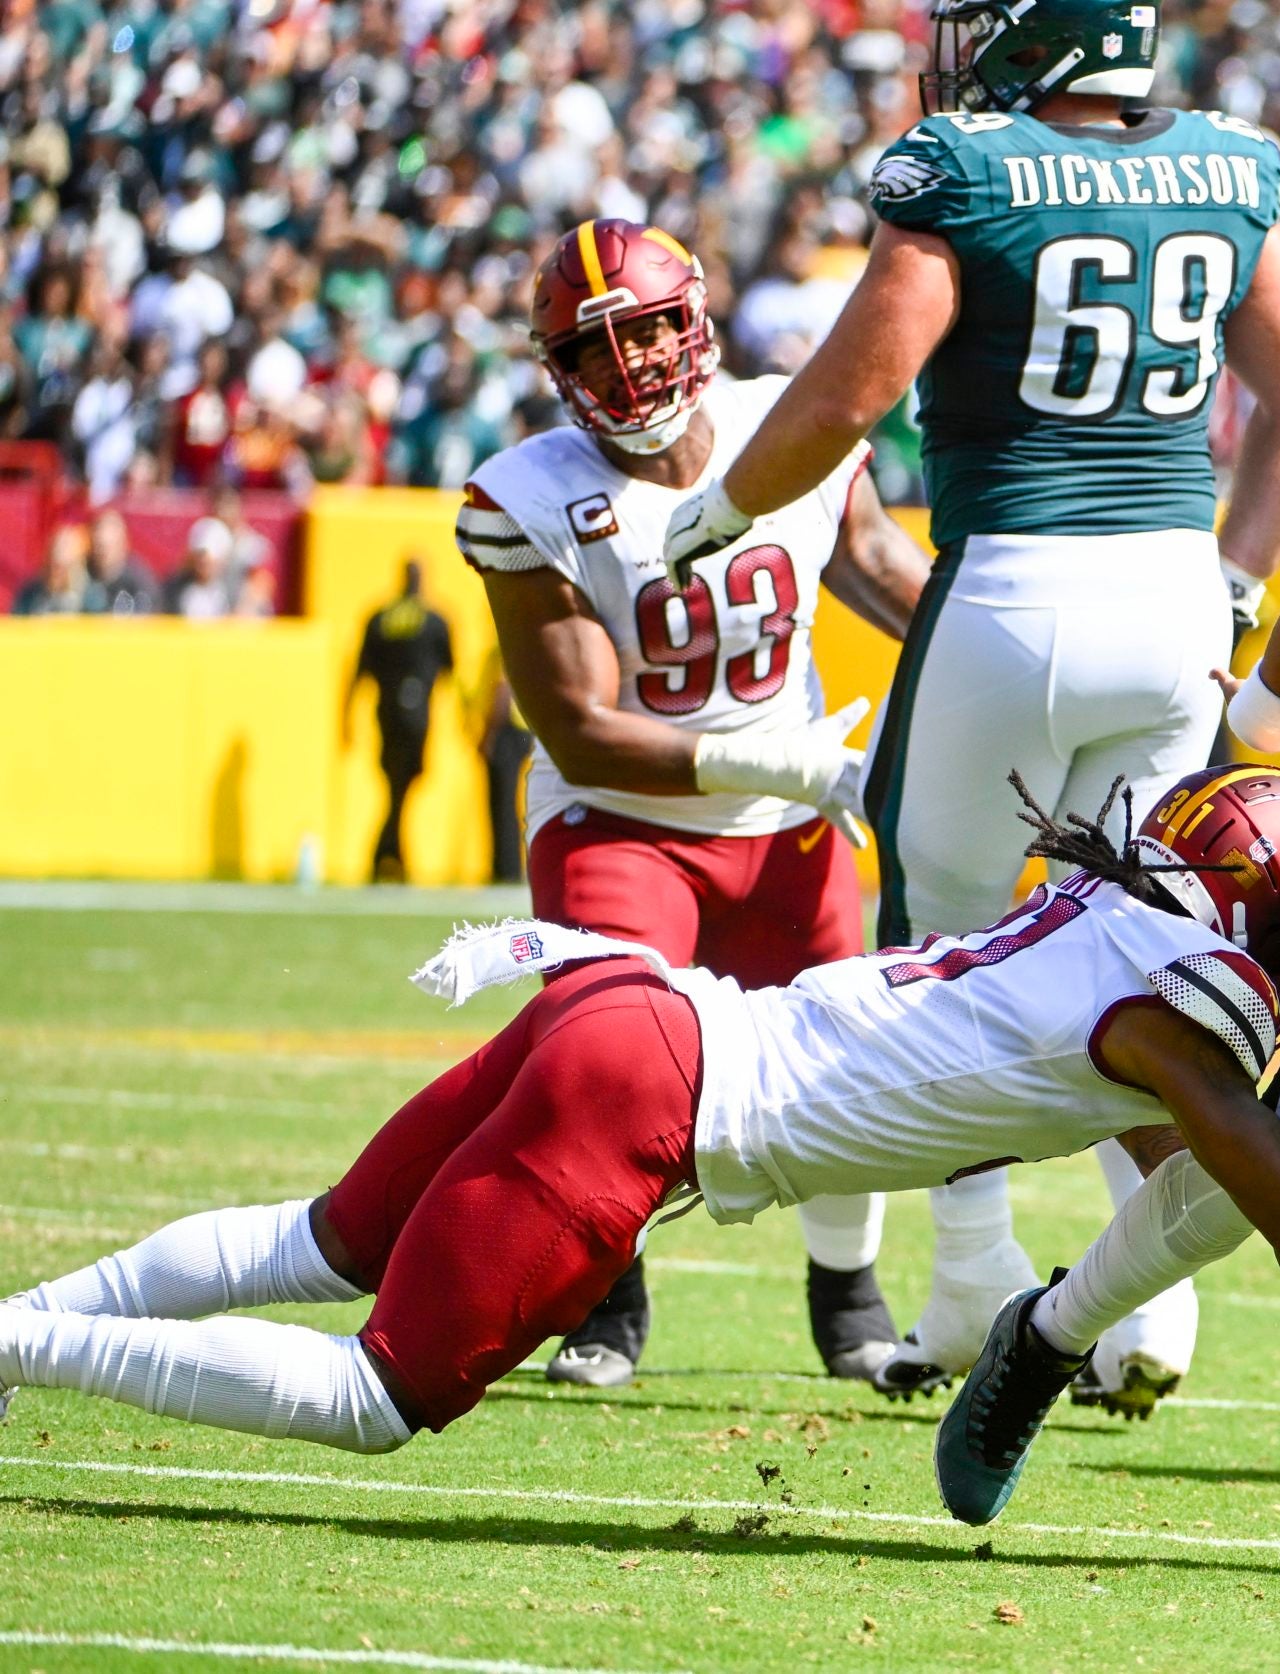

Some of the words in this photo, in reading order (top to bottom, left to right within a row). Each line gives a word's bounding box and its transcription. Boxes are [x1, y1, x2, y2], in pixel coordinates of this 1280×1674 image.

[1003, 154, 1259, 209] DICKERSON
[1018, 232, 1238, 420] 69
[571, 496, 613, 533] C
[635, 544, 798, 714] 93
[512, 936, 531, 962] NFL
